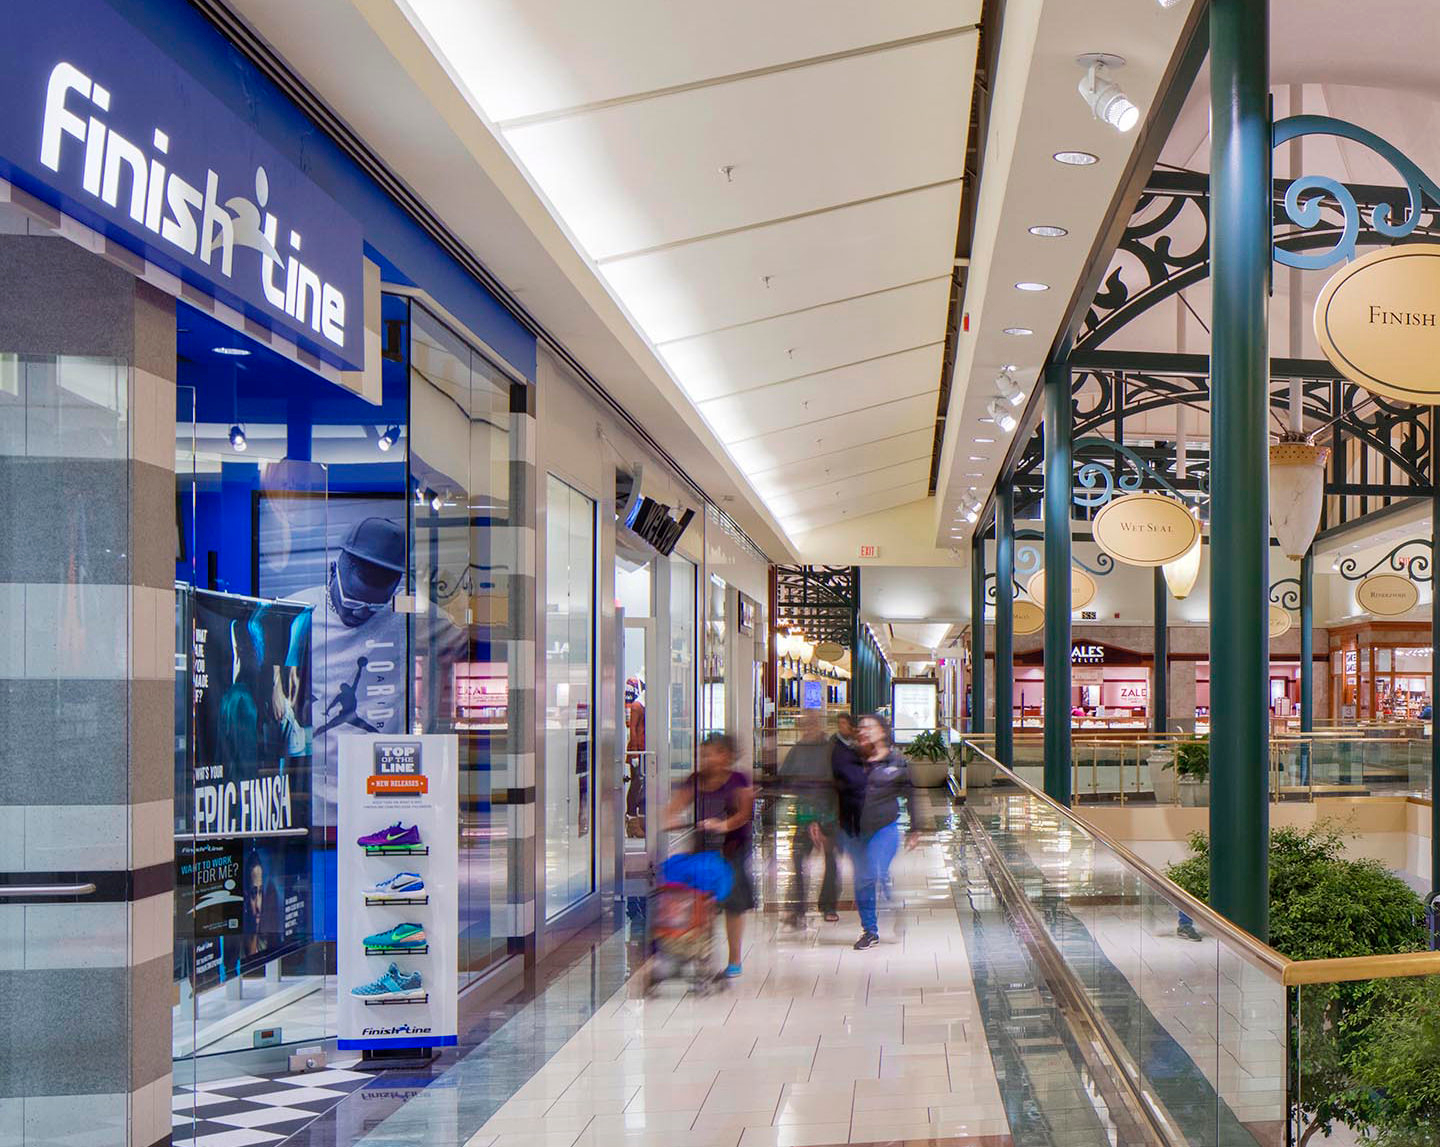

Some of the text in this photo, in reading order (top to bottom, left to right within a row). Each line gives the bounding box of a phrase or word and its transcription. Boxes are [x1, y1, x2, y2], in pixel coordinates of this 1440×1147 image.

[40, 62, 345, 347] Finish Line
[1368, 305, 1436, 327] FINISH
[1120, 522, 1174, 533] WET SEAL
[860, 546, 875, 556] EXIT
[1071, 645, 1104, 658] ALES
[365, 639, 395, 721] JORD
[1120, 688, 1147, 697] ZALE
[381, 746, 415, 757] TOP
[381, 763, 415, 773] LINE
[195, 774, 292, 841] EPIC FINISH
[202, 859, 211, 870] TO
[212, 855, 232, 867] WORK
[197, 862, 239, 885] FOR ME?
[362, 1026, 432, 1036] Finish Line
